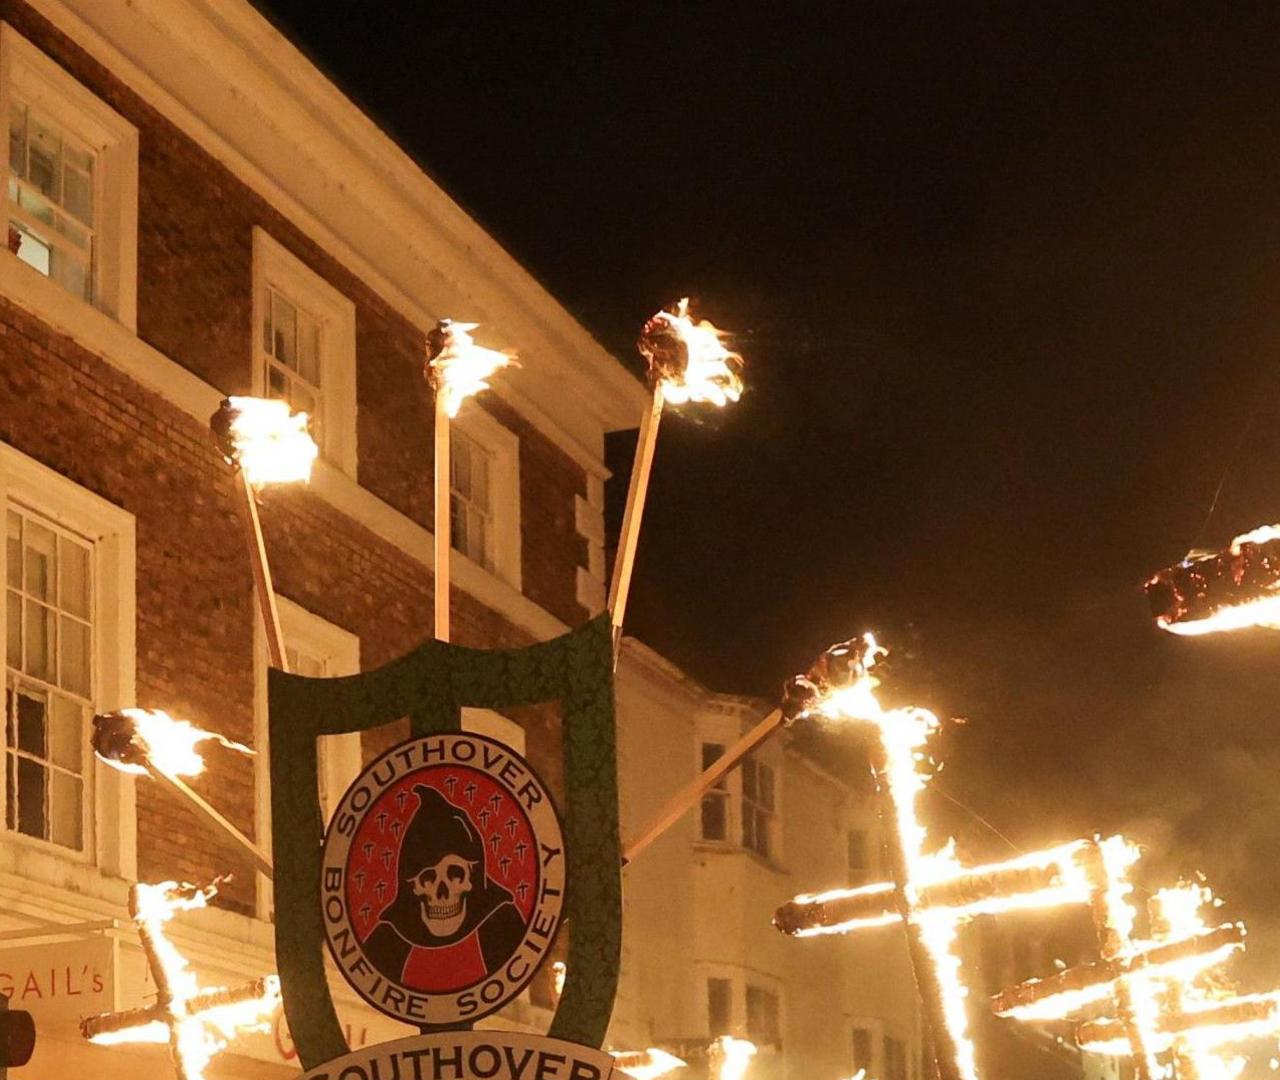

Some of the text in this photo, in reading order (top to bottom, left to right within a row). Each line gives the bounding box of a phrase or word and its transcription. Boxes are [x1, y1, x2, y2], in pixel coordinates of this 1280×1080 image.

[336, 740, 543, 838] SOUTHOVER
[324, 842, 561, 1019] BONFIRE SOCIETY
